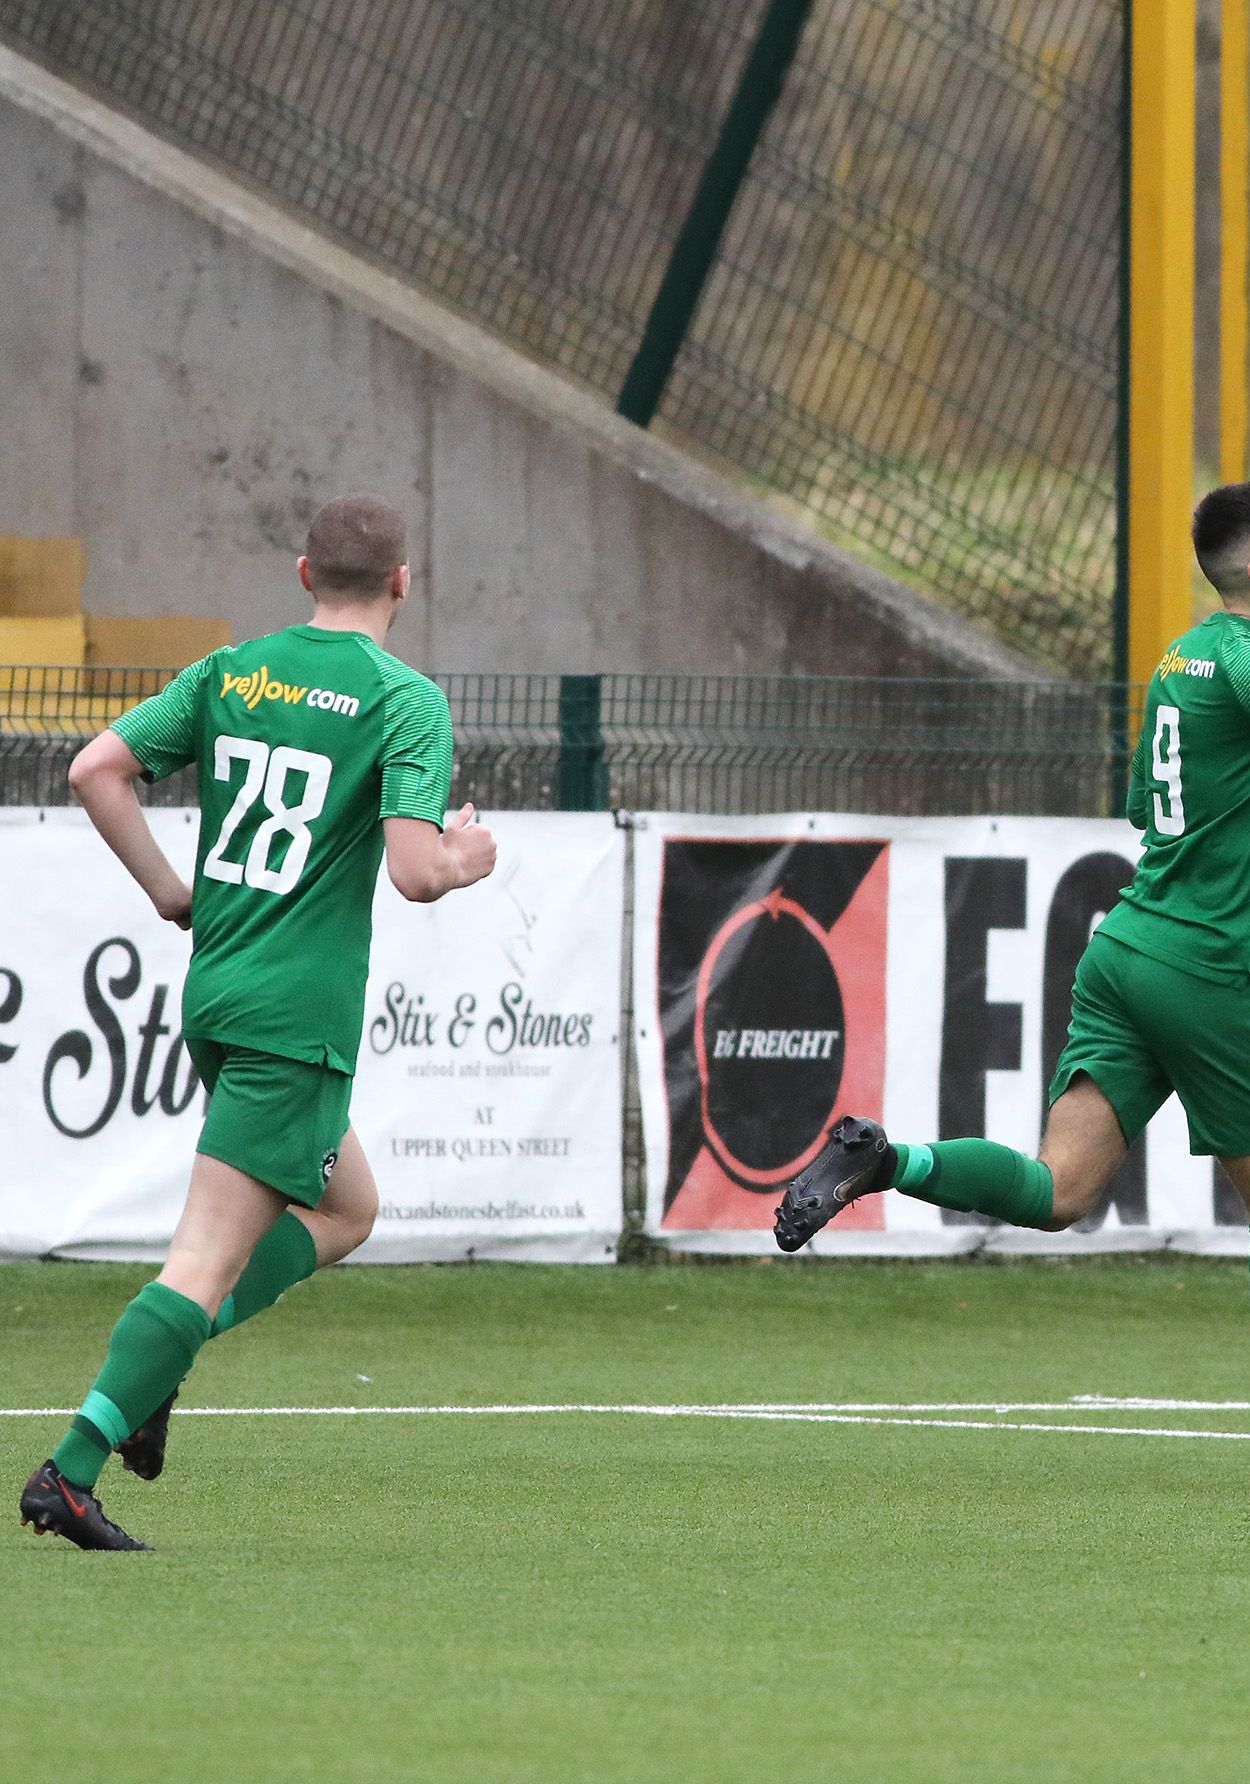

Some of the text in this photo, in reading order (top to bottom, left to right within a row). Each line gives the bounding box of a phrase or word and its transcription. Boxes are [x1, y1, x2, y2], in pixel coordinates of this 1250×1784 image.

[1152, 704, 1187, 836] 9
[203, 734, 333, 896] 28
[42, 935, 211, 1139] Sto
[369, 981, 593, 1055] Stix & Stones
[736, 1029, 840, 1059] FREIGHT
[474, 1105, 495, 1126] AT
[391, 1137, 572, 1161] UPPER QUEEN STREET
[377, 1200, 586, 1221] tixandstonesbelfast.co.uk
